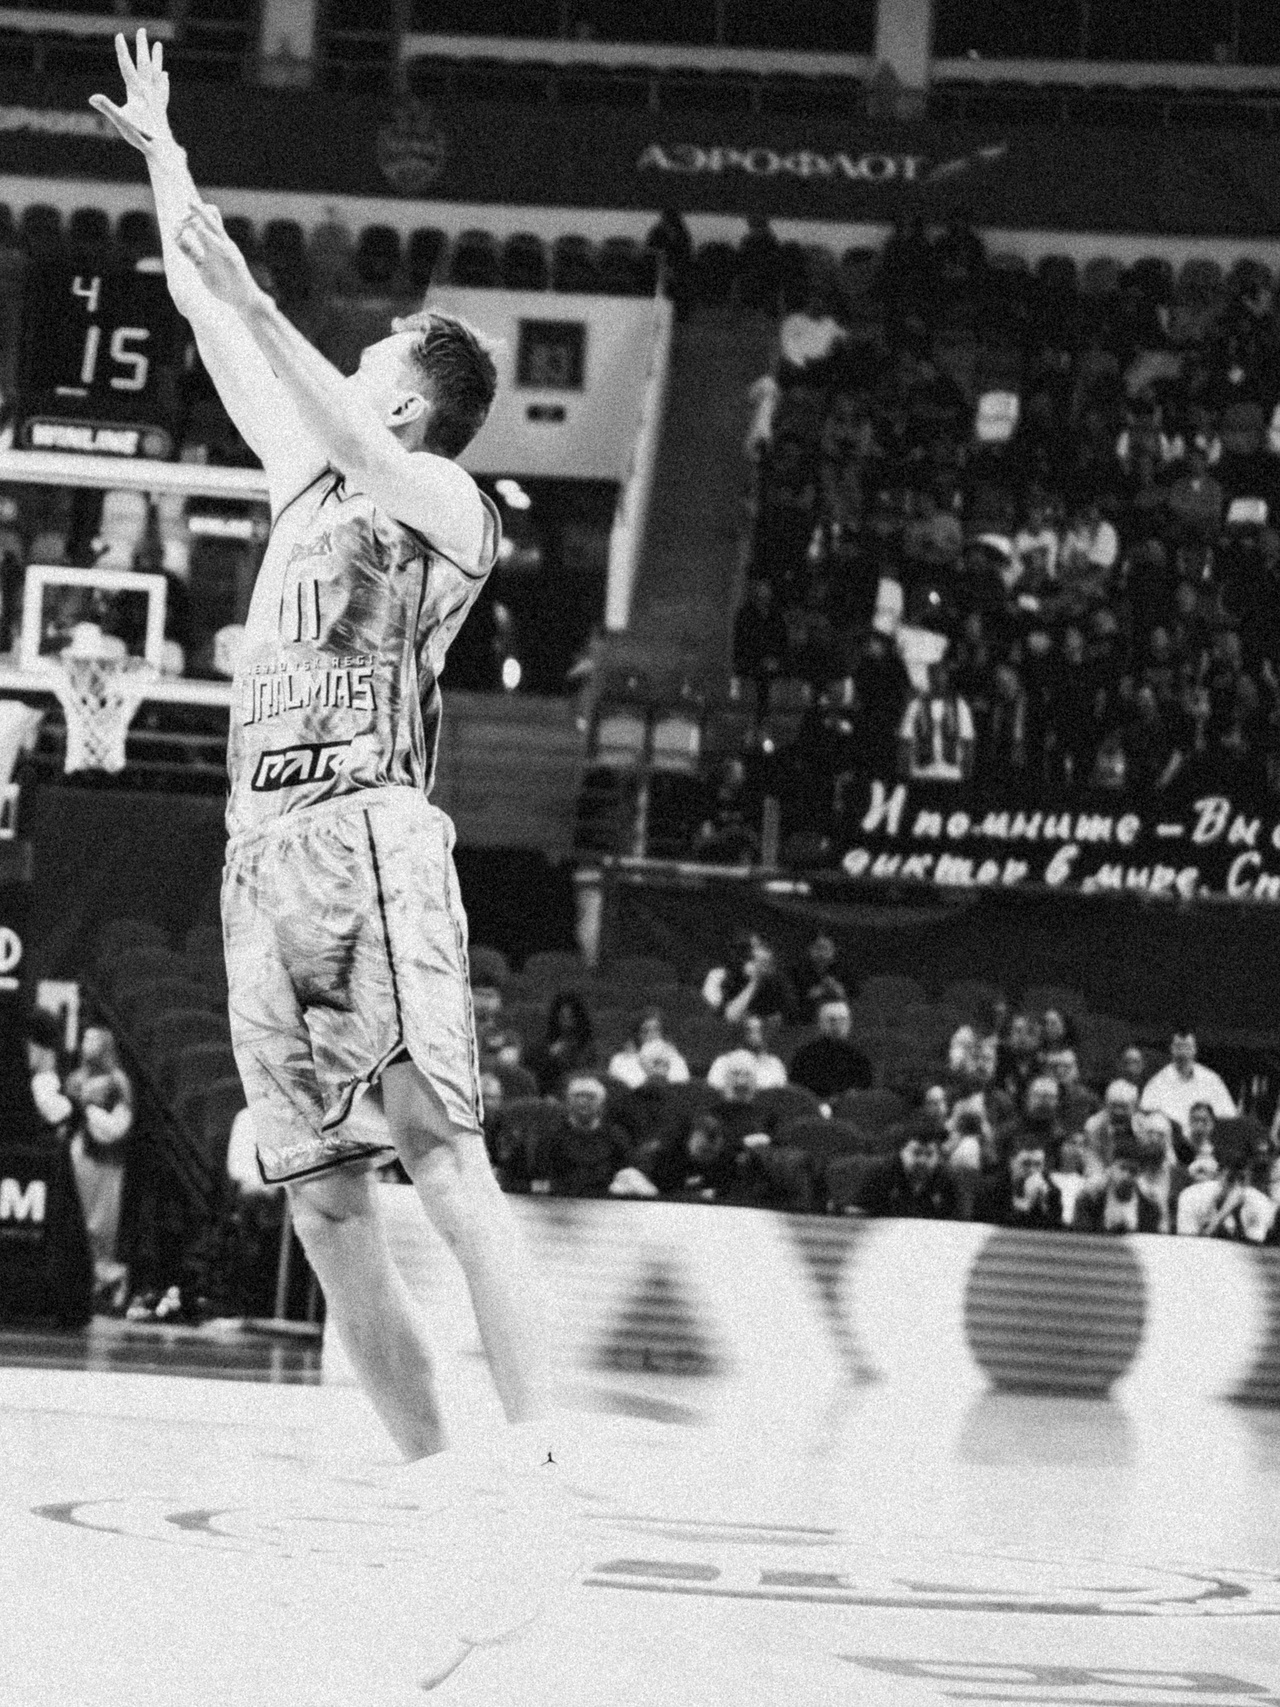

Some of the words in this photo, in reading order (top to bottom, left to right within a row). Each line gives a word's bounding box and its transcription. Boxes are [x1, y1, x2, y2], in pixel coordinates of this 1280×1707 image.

[72, 276, 101, 312] 4
[81, 325, 150, 391] 15
[255, 744, 348, 789] PAR
[862, 781, 907, 836] И
